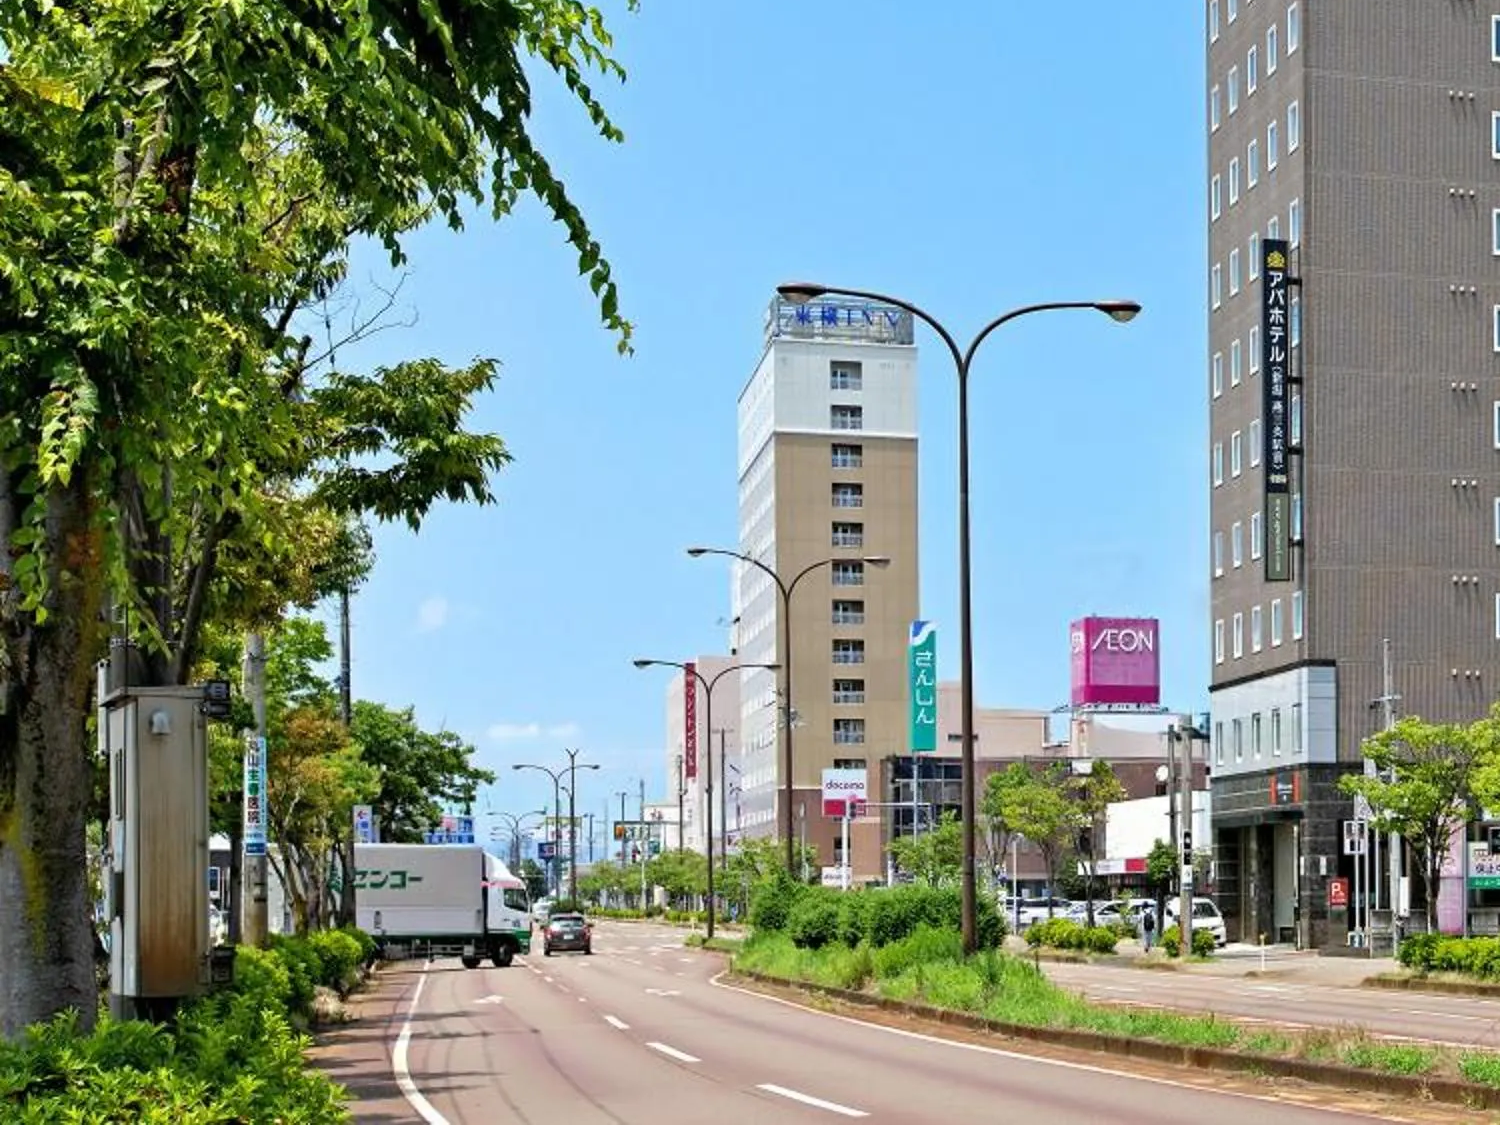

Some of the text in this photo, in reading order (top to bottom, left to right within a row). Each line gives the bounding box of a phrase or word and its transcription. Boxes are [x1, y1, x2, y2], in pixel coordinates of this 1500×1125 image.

[1268, 271, 1285, 363] アパホテル
[916, 650, 935, 724] さんしん
[825, 780, 865, 790] docomo
